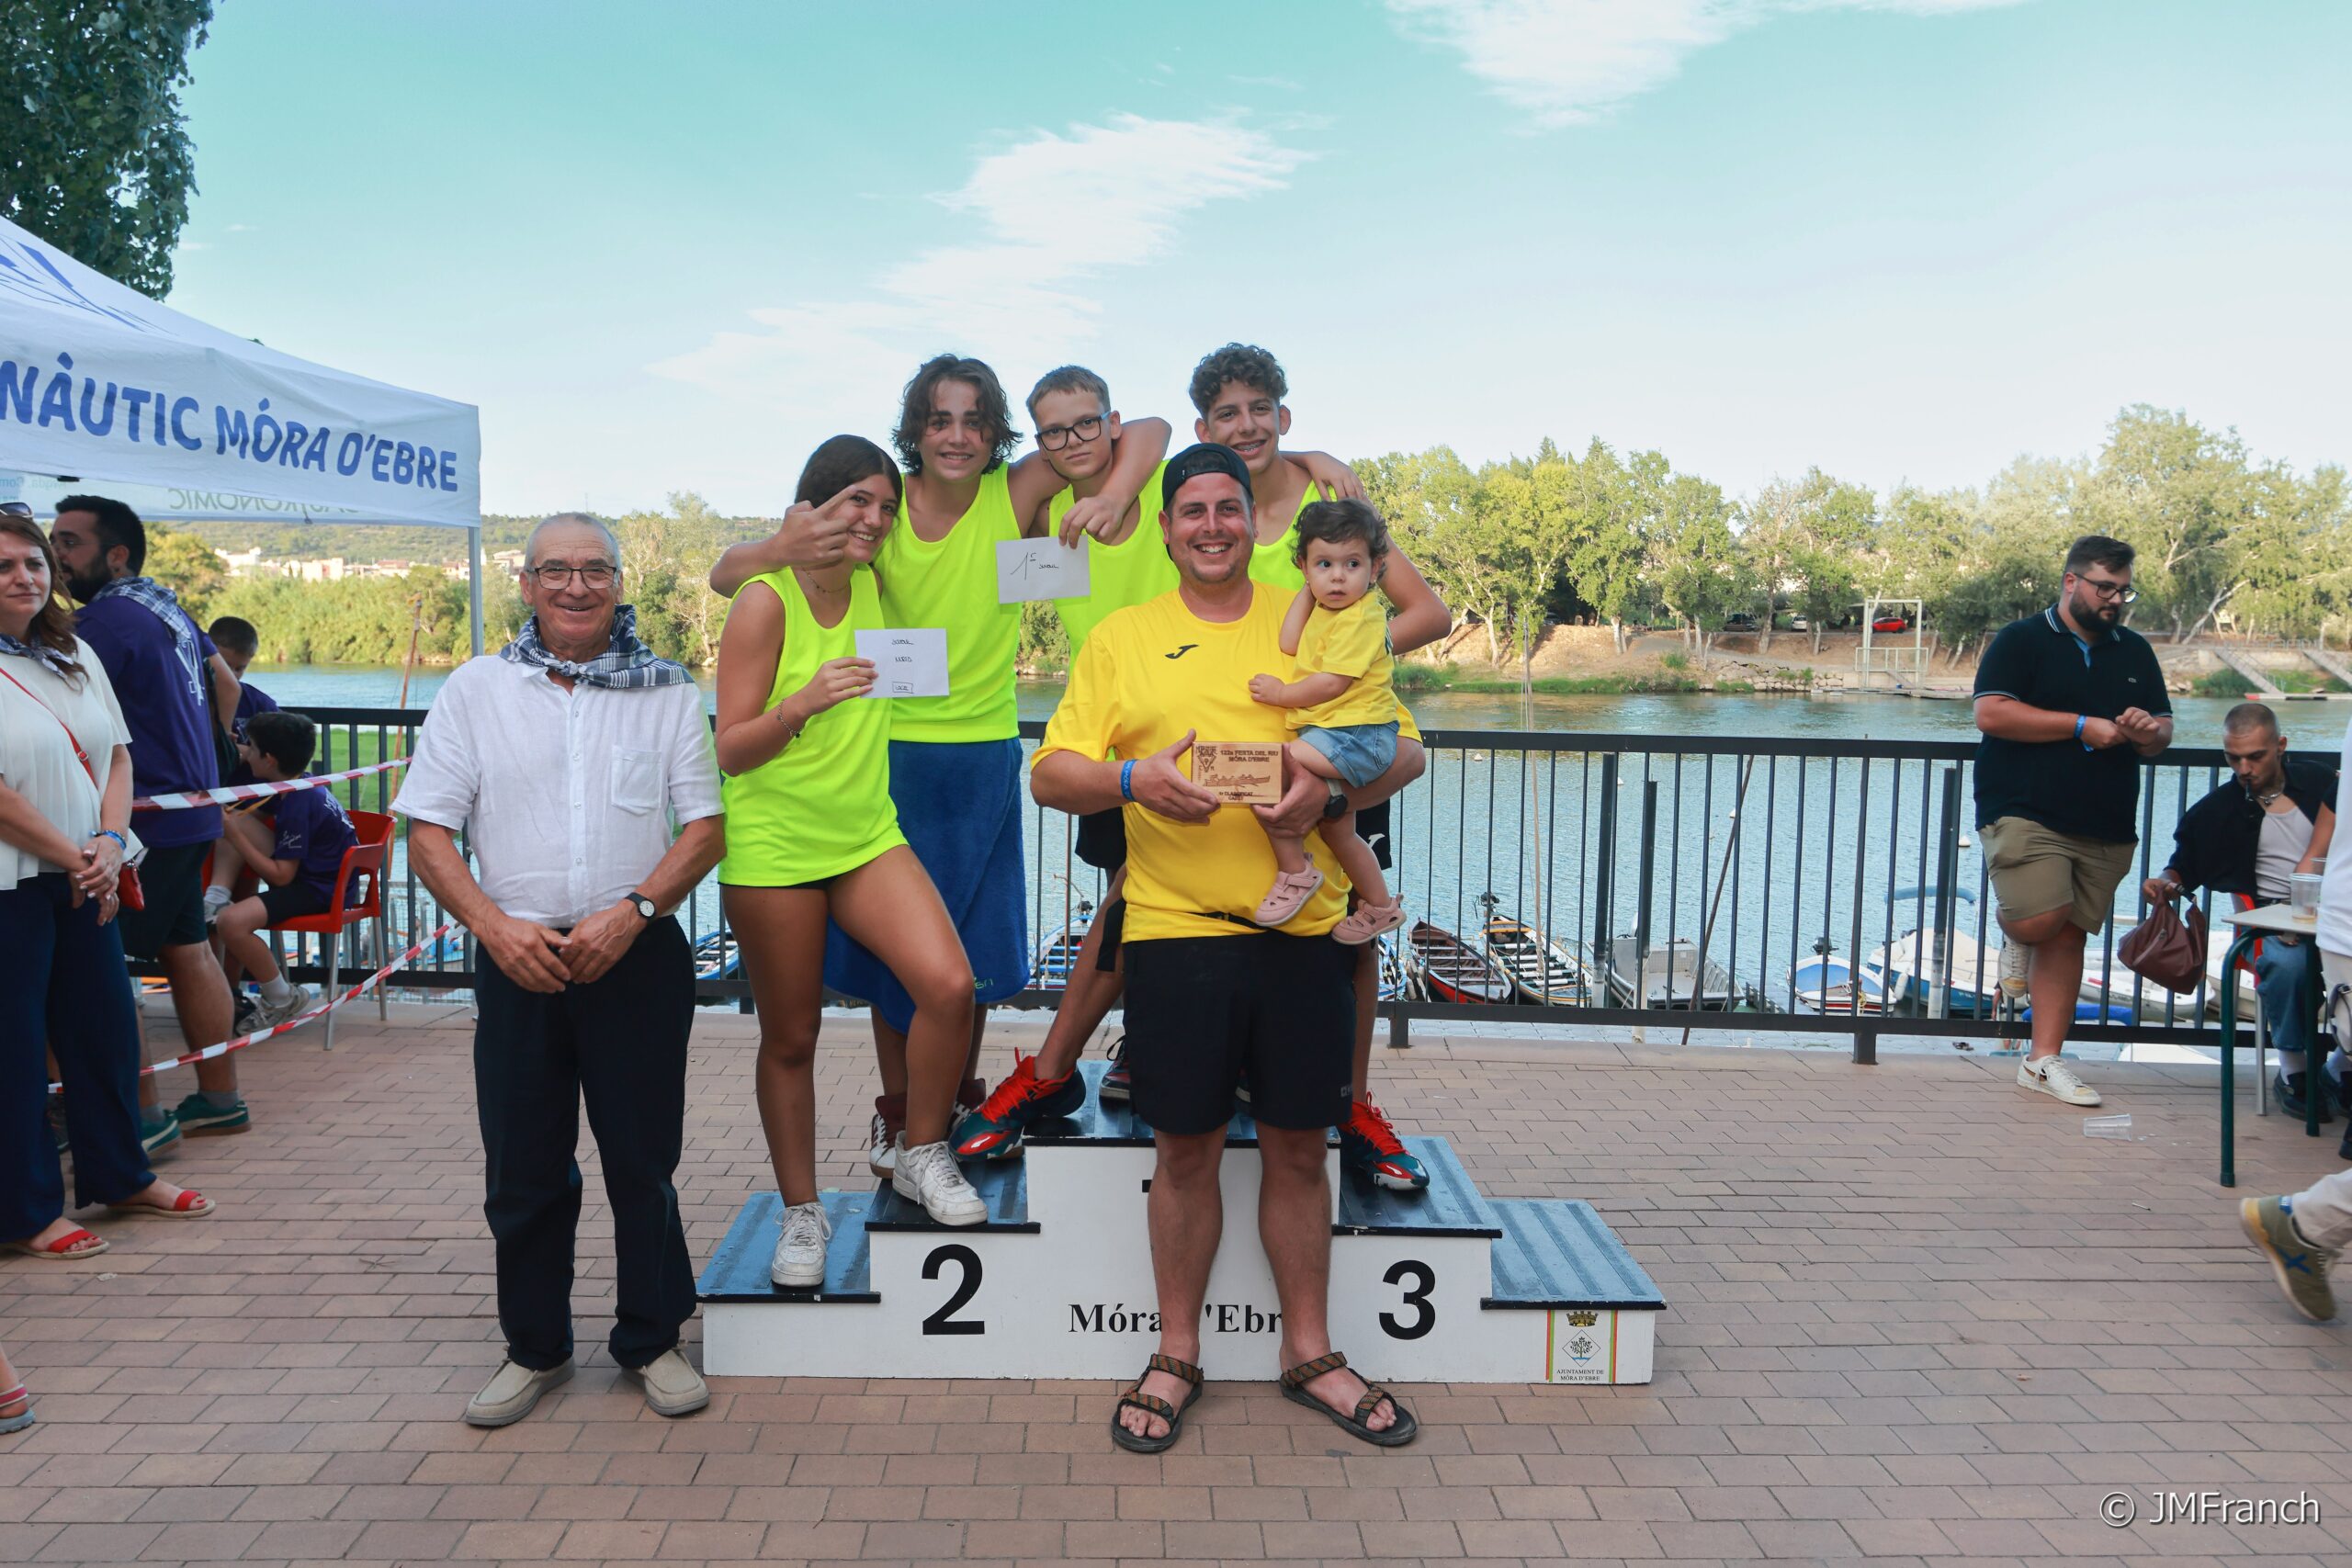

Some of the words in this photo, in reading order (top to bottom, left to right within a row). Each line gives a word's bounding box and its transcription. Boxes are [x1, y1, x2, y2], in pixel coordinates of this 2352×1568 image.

[0, 352, 202, 450] NÀUTIC
[216, 398, 331, 472] MÓRA
[922, 1243, 986, 1336] 2
[1204, 1303, 1283, 1334] 'Ebr
[1378, 1259, 1436, 1340] 3
